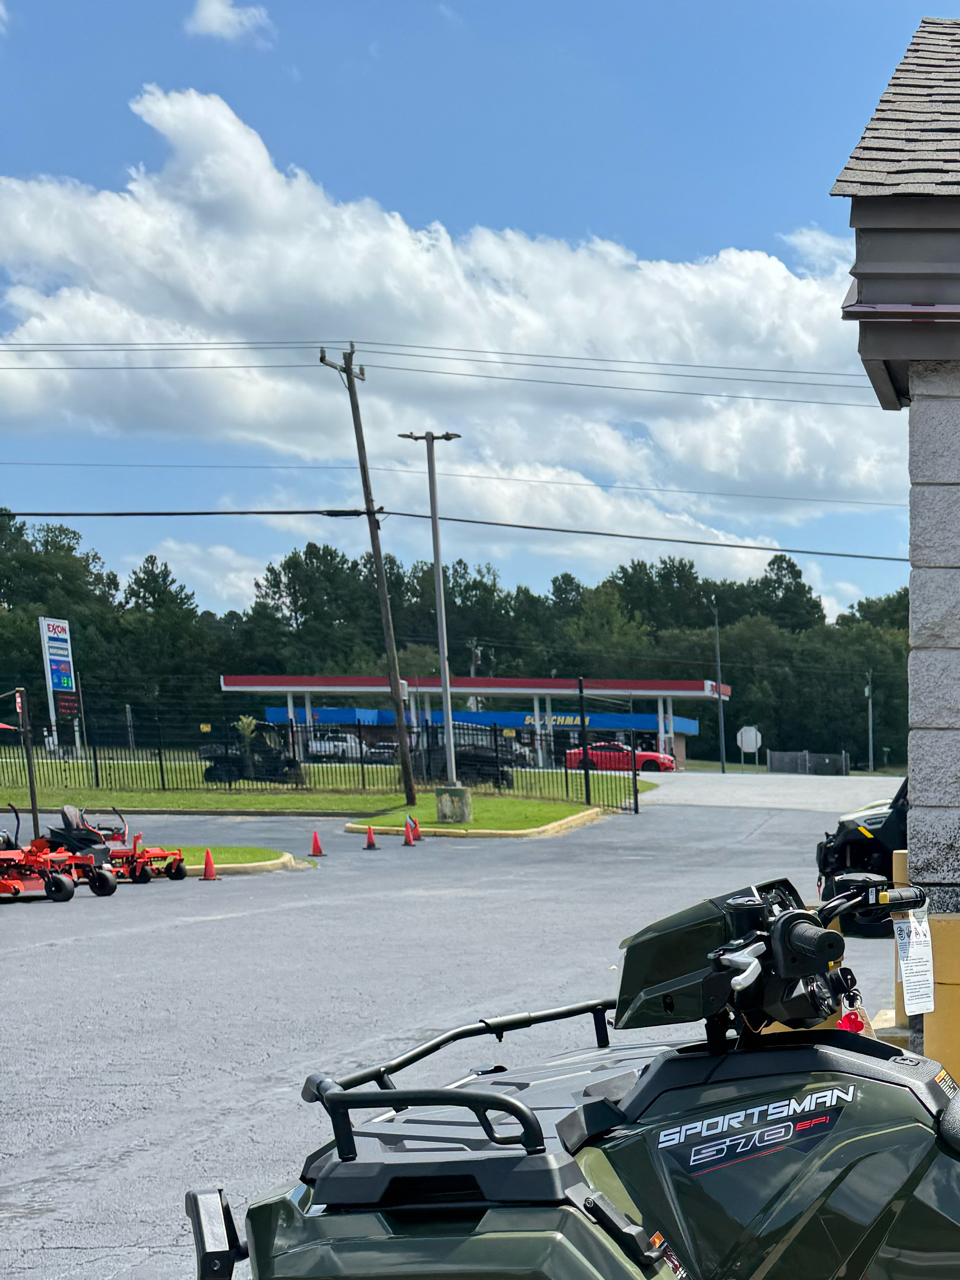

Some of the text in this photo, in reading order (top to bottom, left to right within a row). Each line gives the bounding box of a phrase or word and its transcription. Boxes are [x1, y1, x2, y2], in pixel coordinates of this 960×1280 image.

[47, 623, 67, 637] EXXON
[657, 1084, 857, 1149] SPORTSMAN
[689, 1116, 830, 1166] 570 EFI
